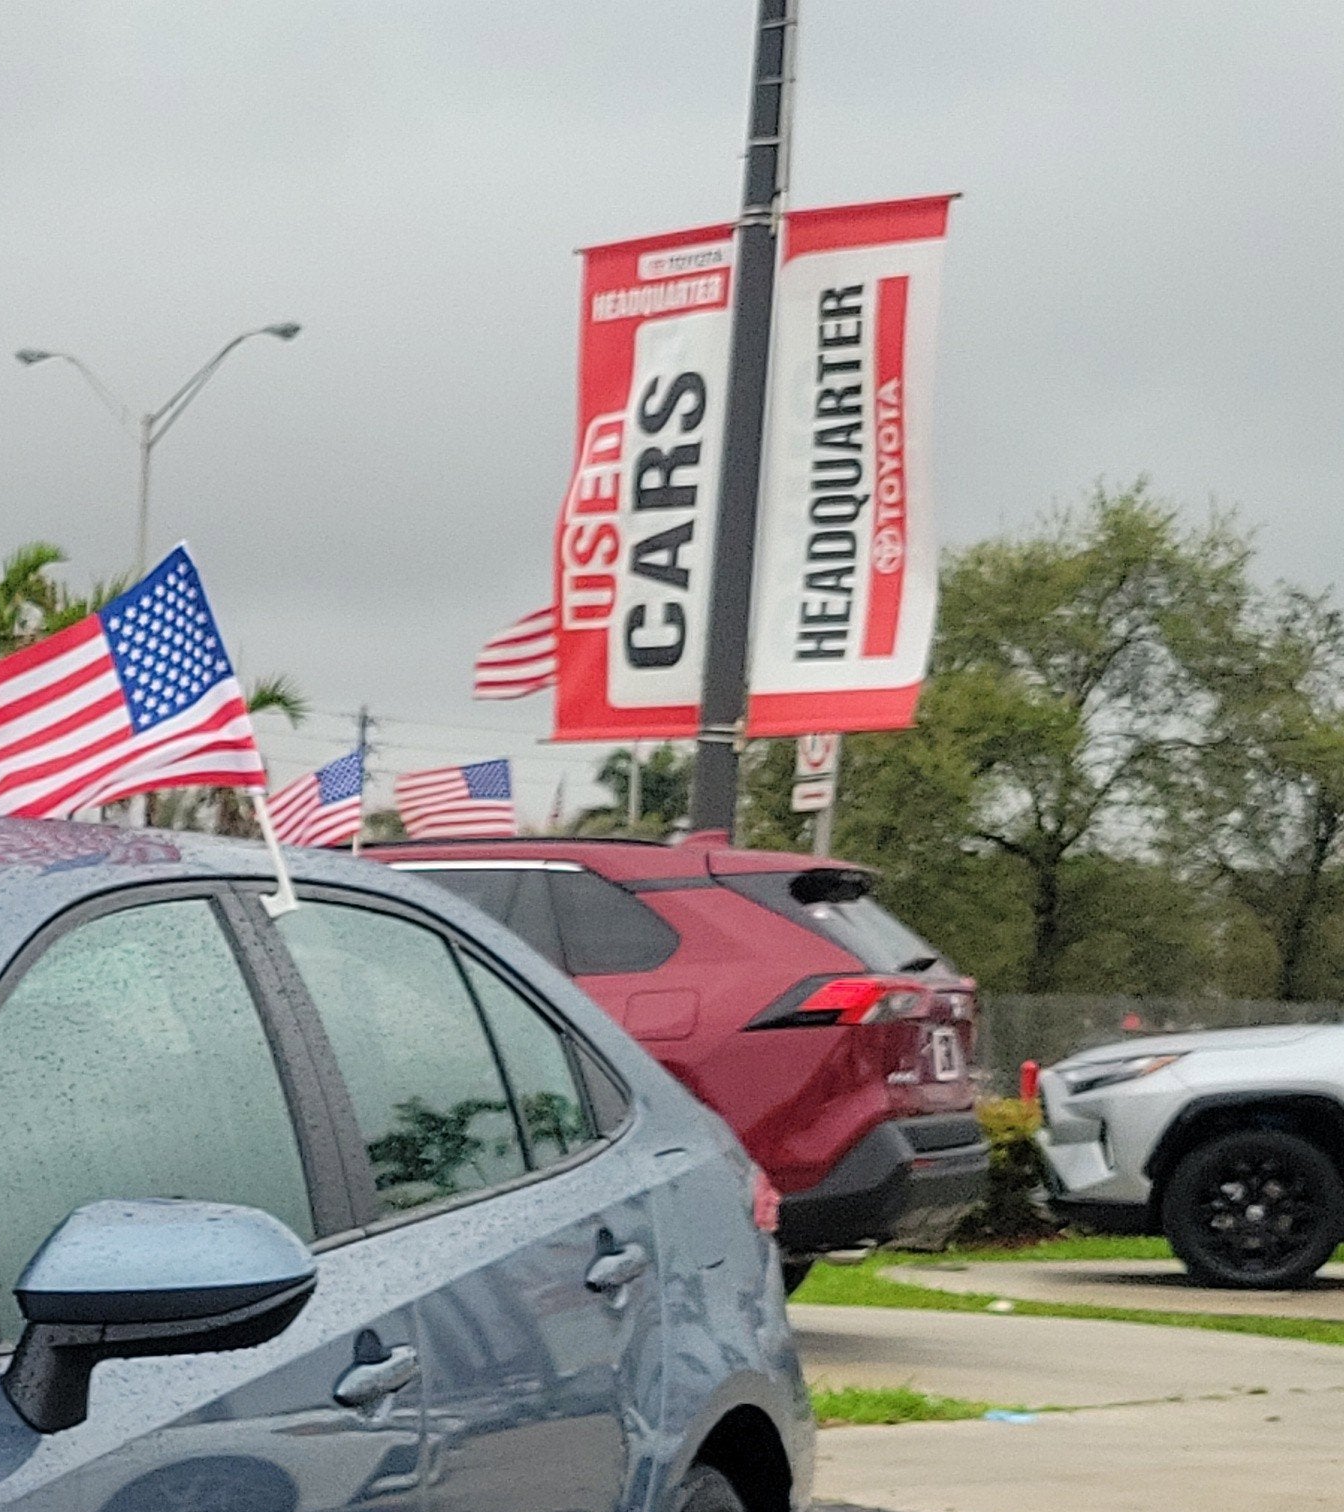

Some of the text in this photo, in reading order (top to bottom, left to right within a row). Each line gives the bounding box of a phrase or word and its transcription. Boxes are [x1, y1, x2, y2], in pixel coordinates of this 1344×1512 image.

[562, 409, 624, 630] USED
[625, 370, 707, 669] CARS
[794, 282, 871, 662] HEADQUARTER
[874, 378, 904, 526] TOYOTA
